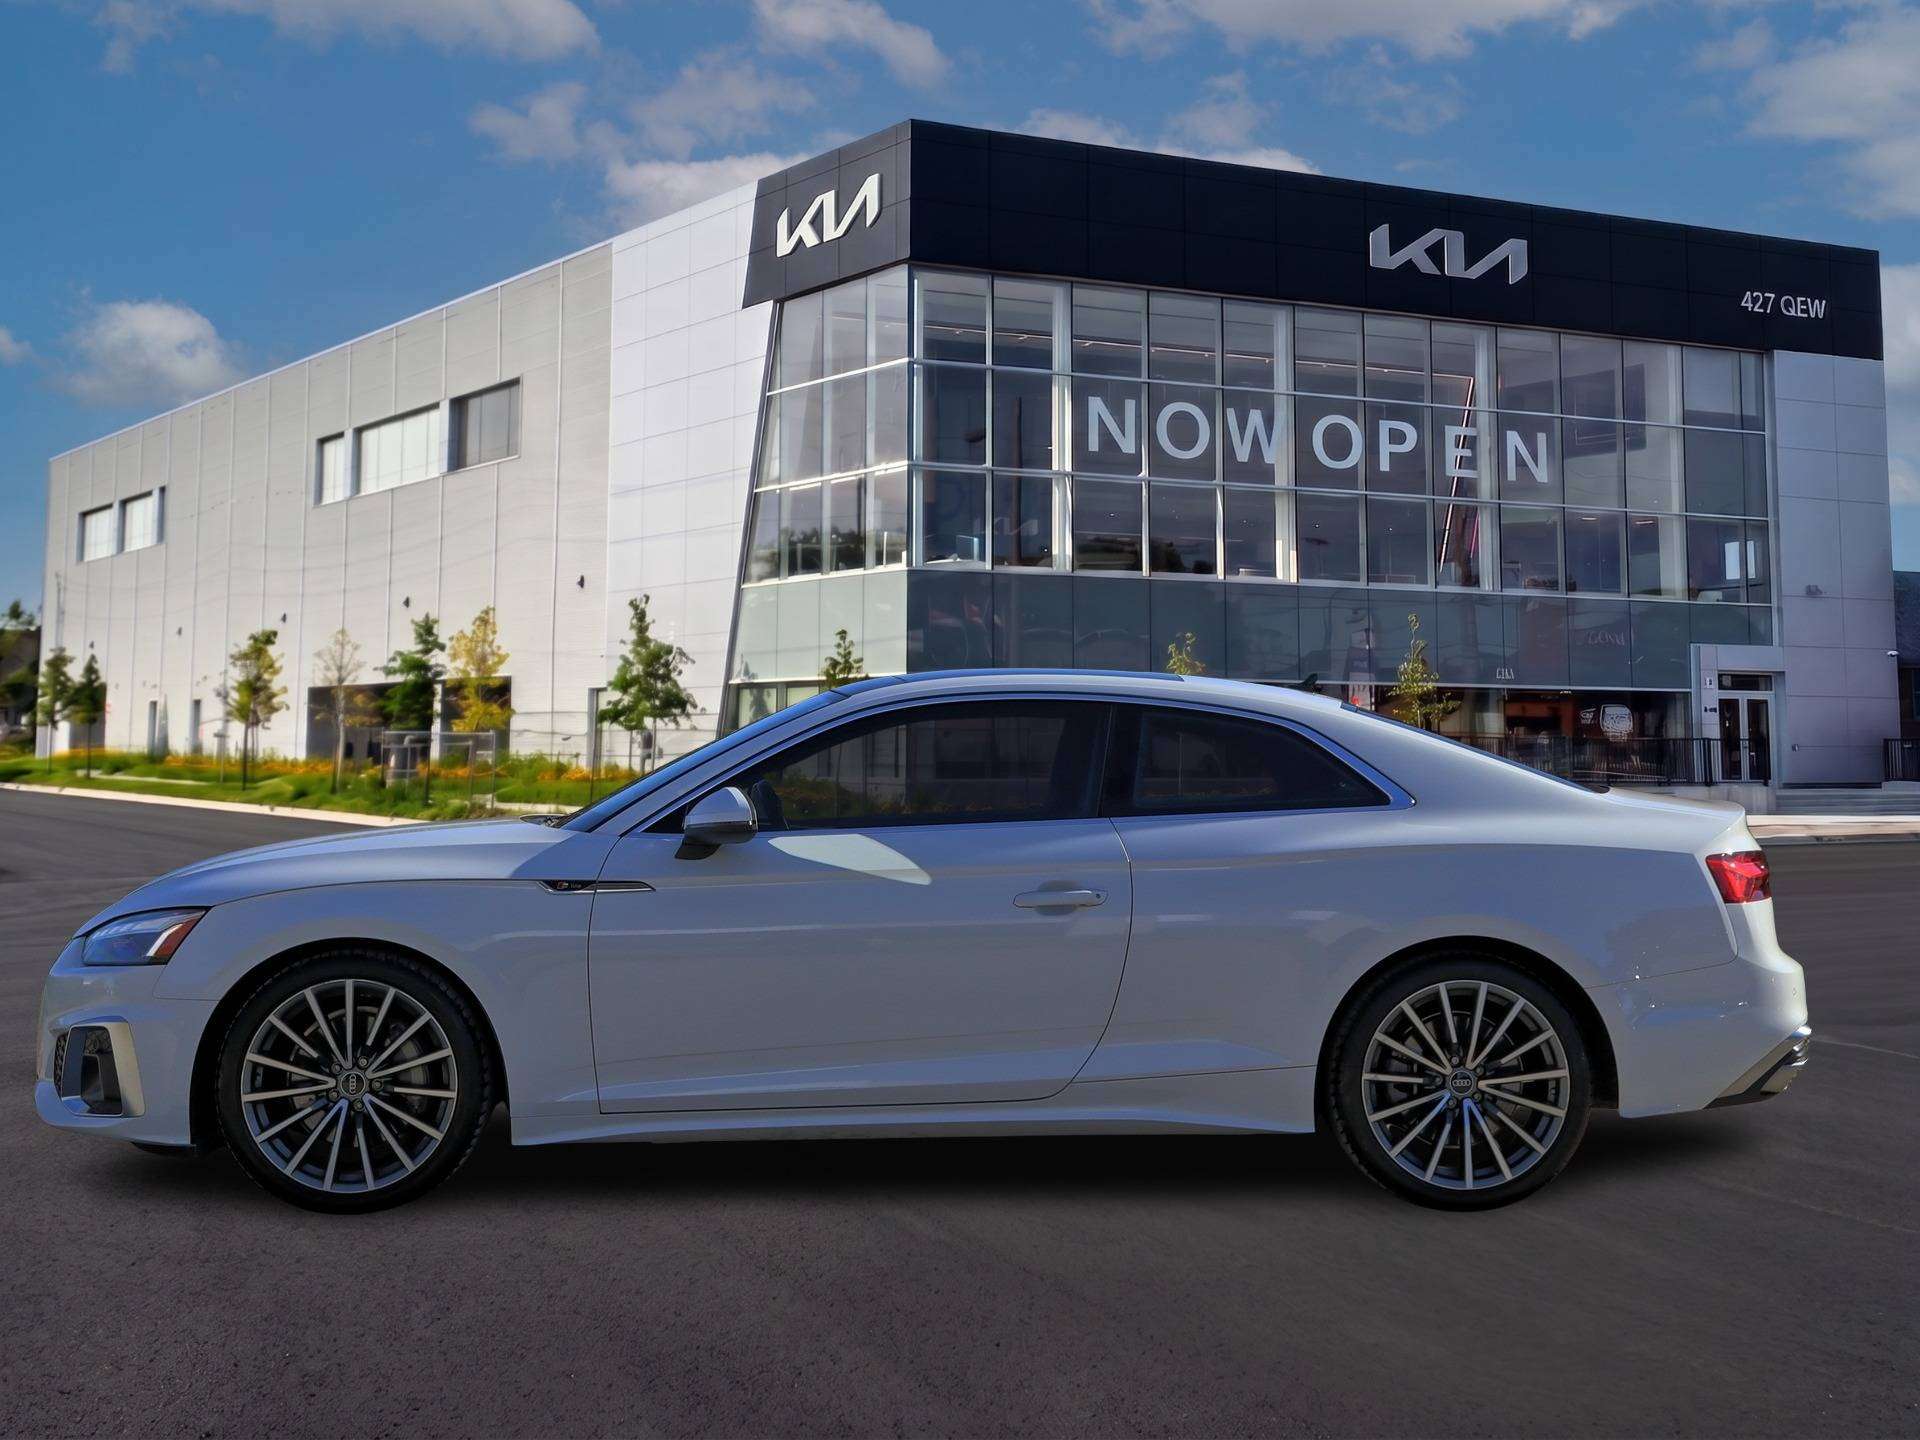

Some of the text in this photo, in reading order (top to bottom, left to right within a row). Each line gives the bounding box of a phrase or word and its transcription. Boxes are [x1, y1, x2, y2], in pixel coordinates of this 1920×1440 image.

[776, 172, 882, 258] KIA
[1369, 223, 1528, 285] KIA
[1740, 291, 1826, 319] 427 QEW
[1087, 396, 1548, 483] NOW OPEN
